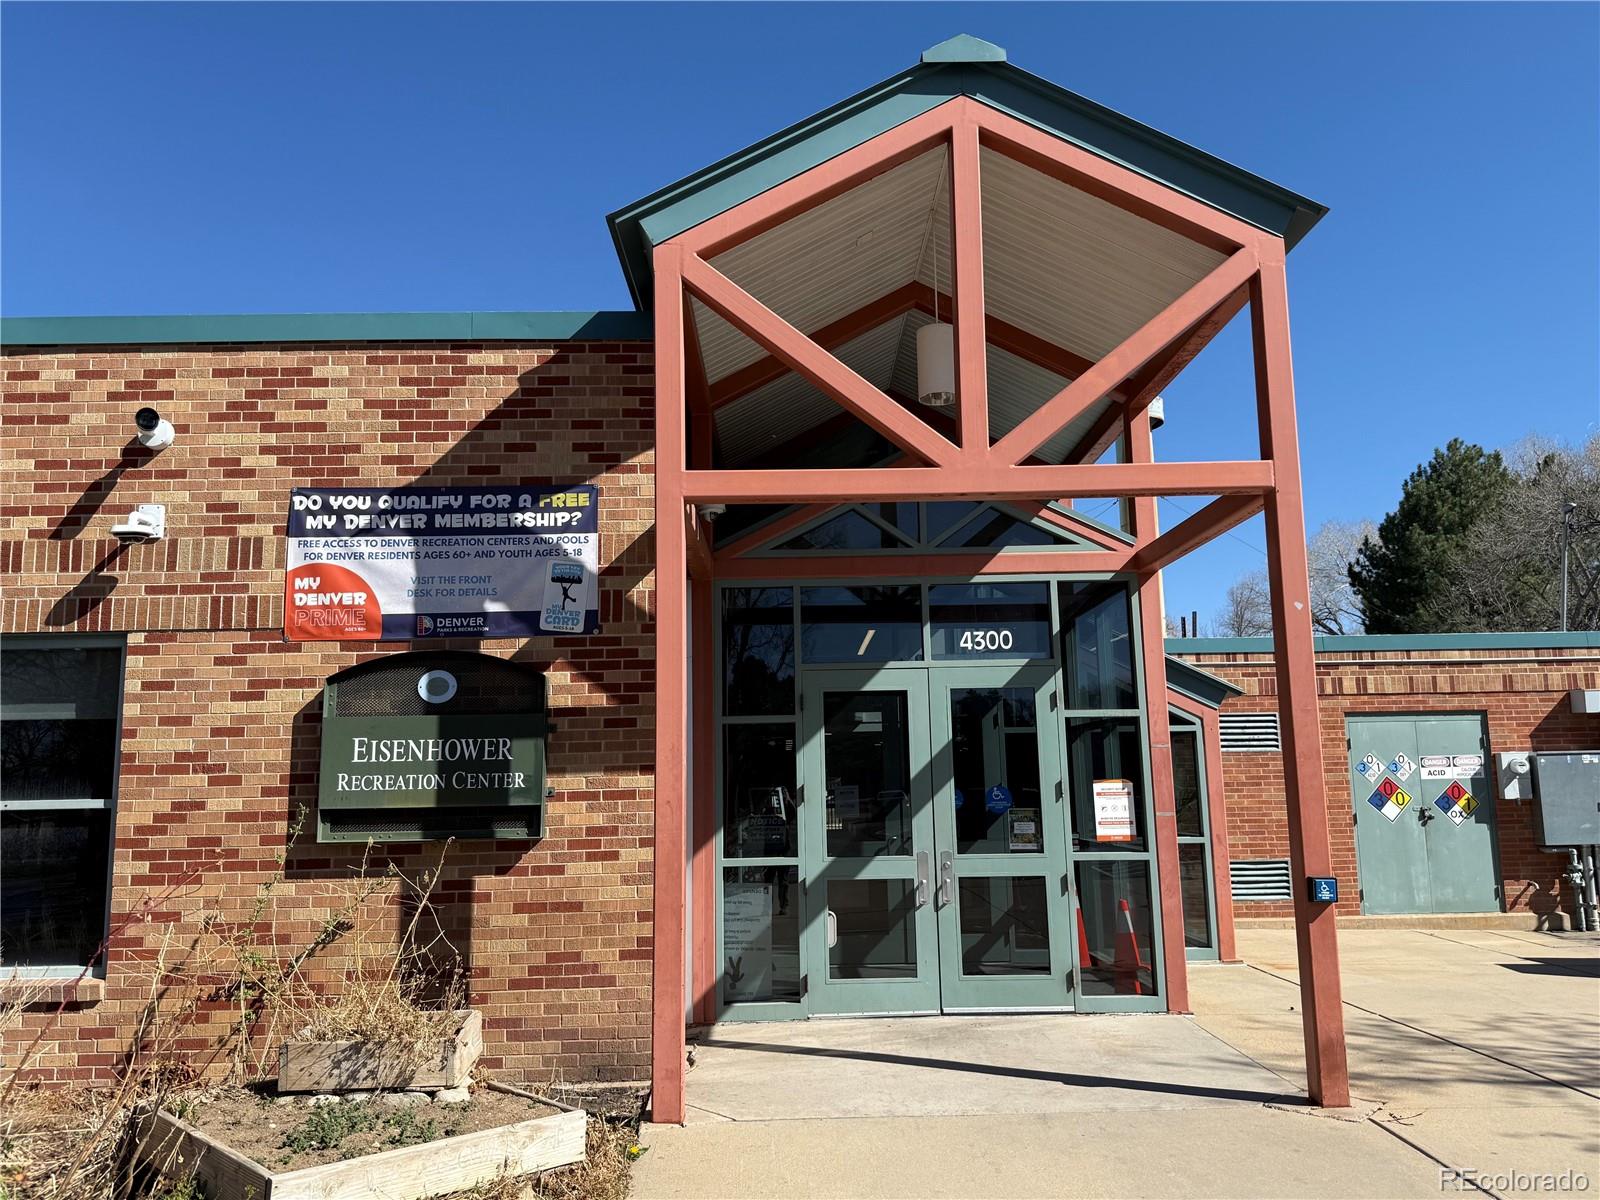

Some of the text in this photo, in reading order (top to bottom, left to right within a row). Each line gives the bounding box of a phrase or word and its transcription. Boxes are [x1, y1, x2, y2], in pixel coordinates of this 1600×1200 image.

[292, 493, 590, 510] DO YOU QUALIFY FOR A FREE
[306, 512, 582, 530] MY DENVER MEMBERSHIP?
[298, 535, 589, 548] FREE ACCESS TO DENVER RECREATION CENTERS AND POOLS
[304, 548, 582, 561] FOR DENVER RESIDENTS AGES 60+ AND YOUTH AGES 5-18
[295, 577, 320, 590] MY
[411, 576, 492, 585] VISIT THE FRONT
[294, 592, 367, 606] DENVER
[408, 588, 497, 598] DESK FOR DETAILS
[295, 608, 366, 626] PRIME
[546, 608, 581, 617] DENVER
[437, 617, 483, 627] DENVER
[545, 615, 580, 626] CARD
[960, 630, 1013, 650] 4300
[352, 738, 513, 762] EISENHOWER
[1366, 755, 1373, 764] 0
[1398, 755, 1404, 764] 0
[1360, 763, 1366, 772] 3
[1392, 763, 1398, 772] 3
[337, 772, 525, 791] RECREATION CENTER
[1384, 782, 1392, 796] 0
[1452, 785, 1460, 799] 0
[1374, 792, 1405, 807] 3 0
[1442, 796, 1470, 811] 3 1
